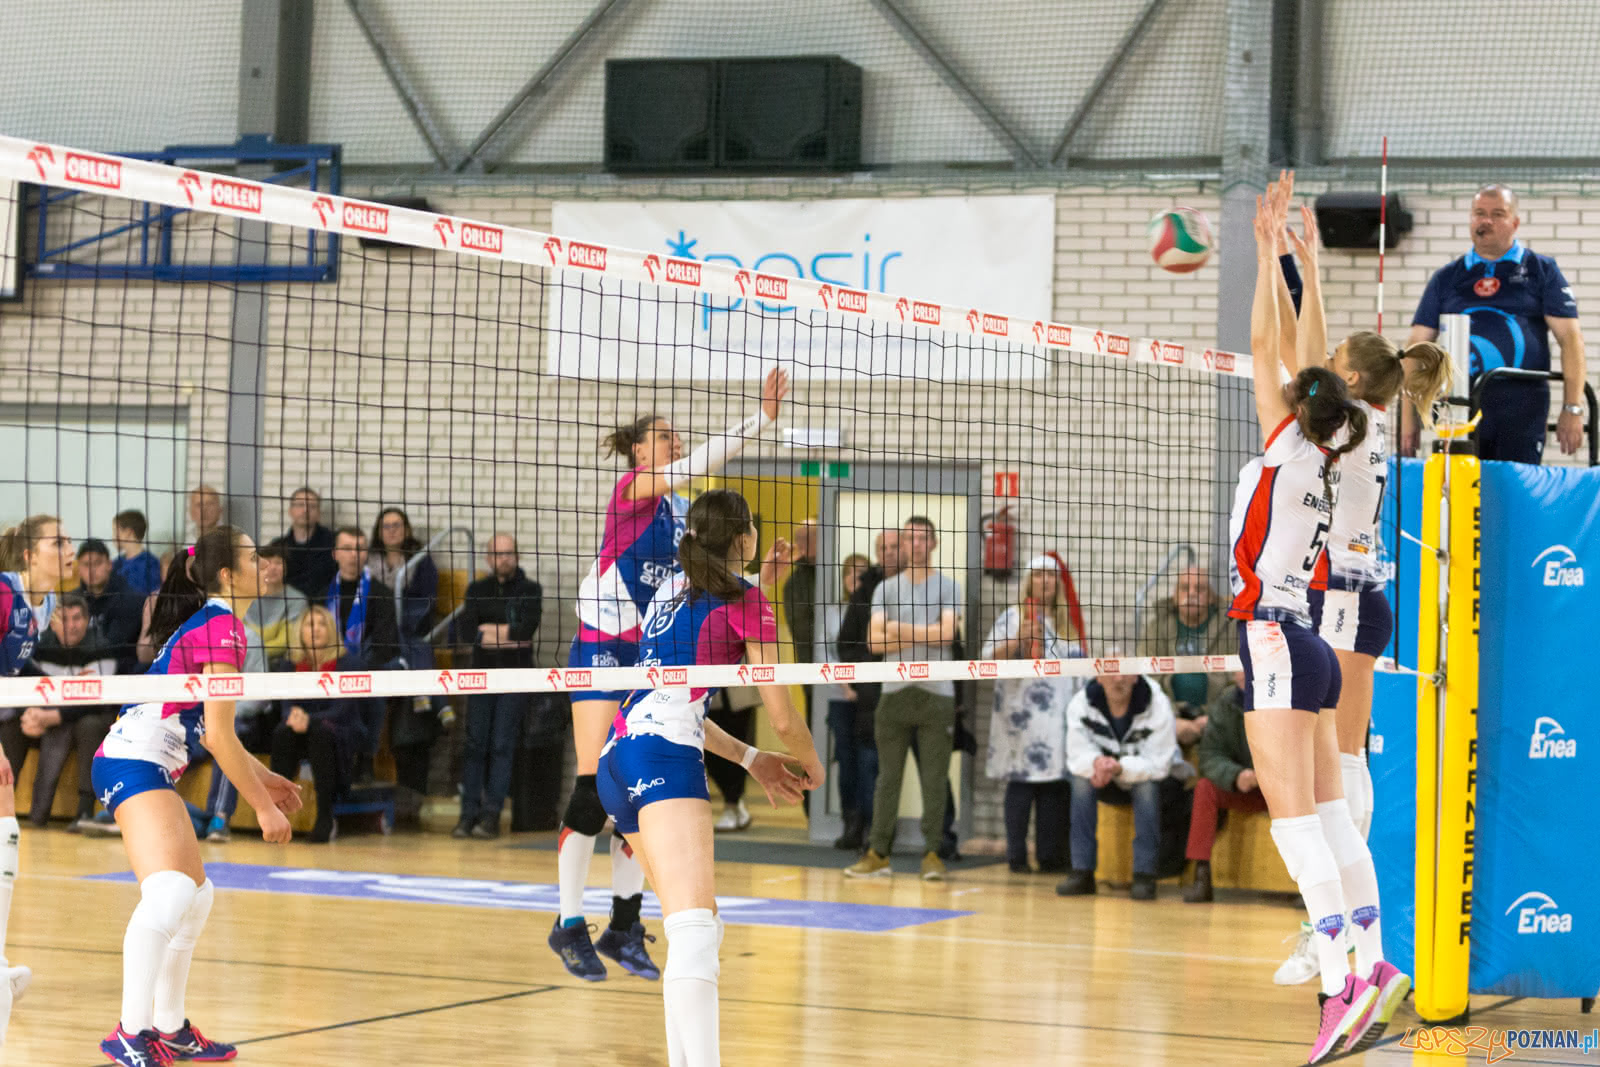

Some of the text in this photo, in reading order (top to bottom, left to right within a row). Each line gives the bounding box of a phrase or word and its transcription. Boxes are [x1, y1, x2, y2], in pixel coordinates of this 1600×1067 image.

[67, 156, 119, 185] ORLEN
[213, 183, 260, 210] ORLEN
[347, 206, 386, 231] ORLEN
[463, 227, 501, 250] ORLEN
[570, 244, 605, 268] ORLEN
[667, 262, 700, 284] ORLEN
[757, 277, 786, 297] ORLEN
[839, 291, 866, 311] ORLEN
[915, 305, 939, 322] ORLEN
[985, 316, 1007, 334] ORLEN
[1049, 328, 1071, 344] ORLEN
[1108, 338, 1128, 353] ORLEN
[1164, 346, 1183, 361] ORLEN
[1303, 521, 1329, 572] 5
[1544, 561, 1584, 587] Enea
[664, 670, 686, 683] ORLEN
[753, 668, 774, 680] ORLEN
[835, 667, 854, 678] ORLEN
[910, 666, 928, 676] ORLEN
[980, 664, 997, 675] ORLEN
[210, 679, 241, 696] ORLEN
[341, 676, 370, 692] ORLEN
[459, 674, 485, 688] ORLEN
[567, 673, 590, 686] ORLEN
[64, 682, 100, 698] ORLEN
[1529, 733, 1577, 760] Enea
[1518, 908, 1572, 934] Enea
